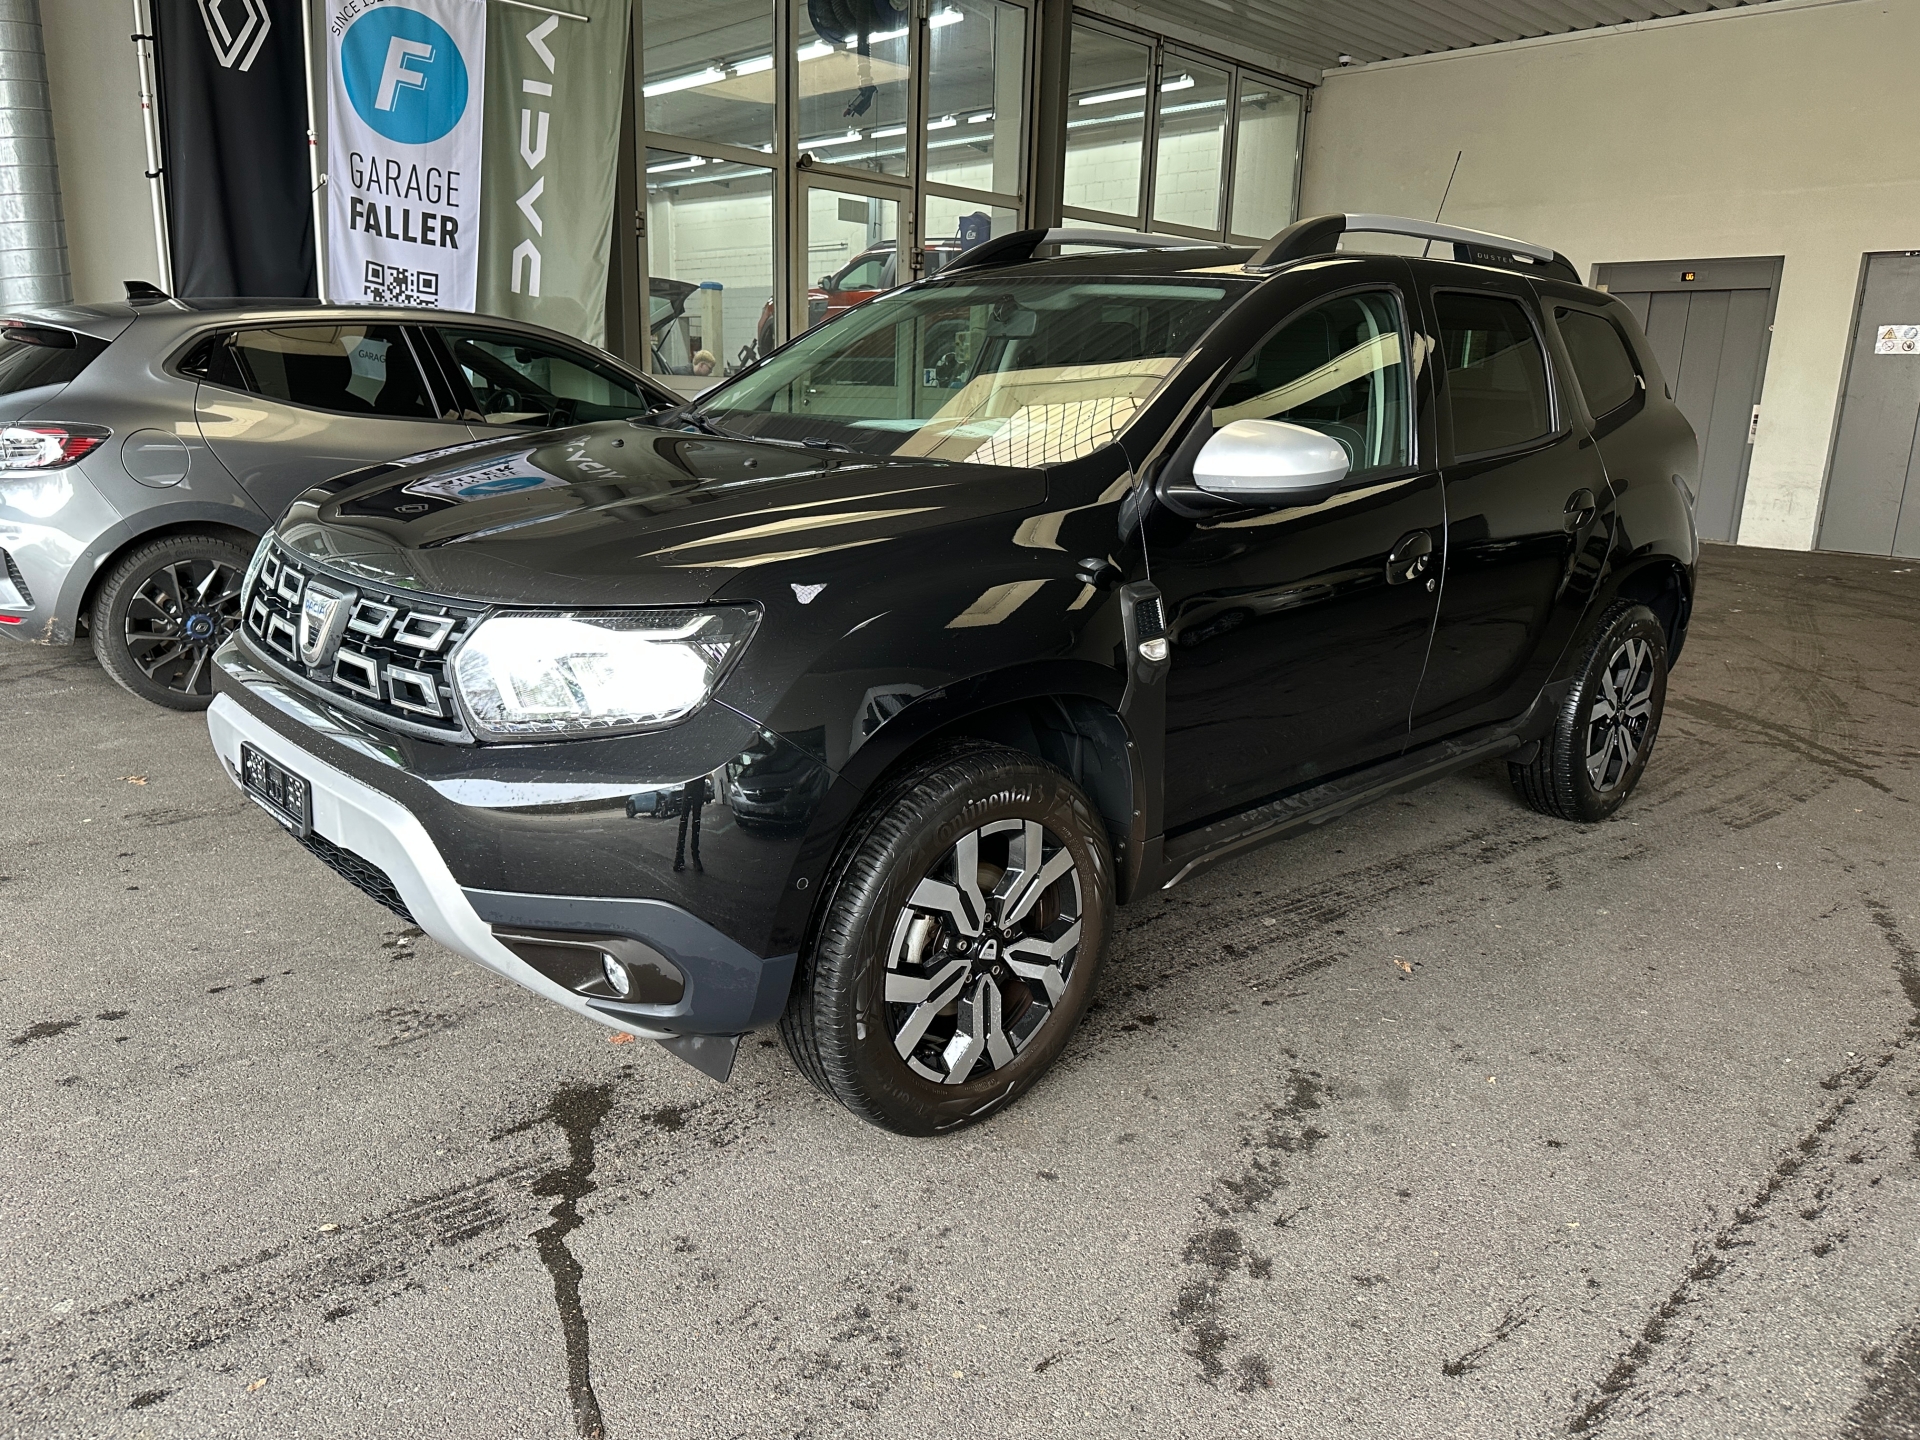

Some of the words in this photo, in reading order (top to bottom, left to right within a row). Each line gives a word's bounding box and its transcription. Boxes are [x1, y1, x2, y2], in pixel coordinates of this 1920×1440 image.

[331, 0, 361, 37] SINCE
[374, 35, 436, 112] F
[349, 151, 460, 208] GARAGE
[511, 14, 559, 298] DACIA
[349, 196, 459, 250] FALLER
[1477, 252, 1515, 265] DUSTER
[934, 783, 1033, 846] Continental
